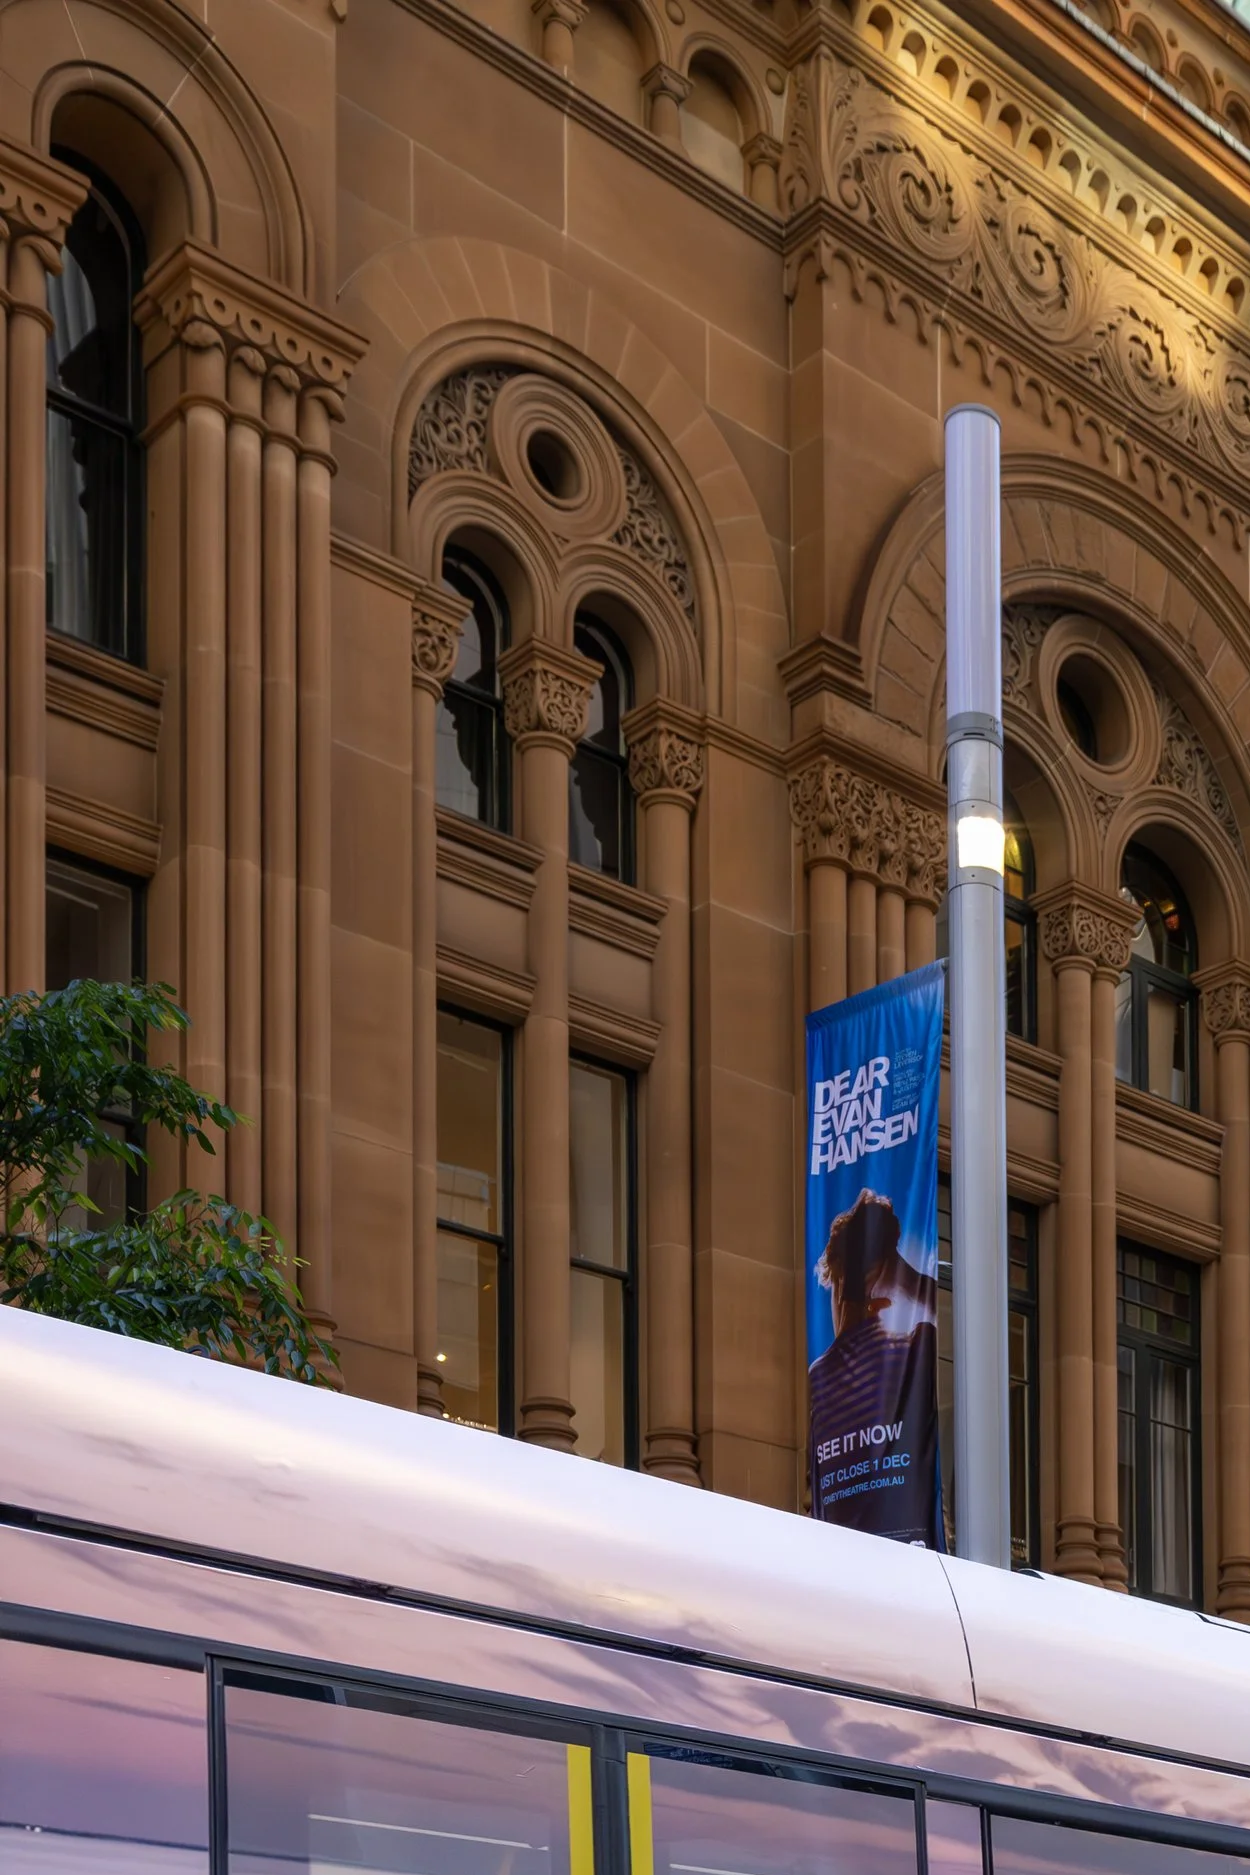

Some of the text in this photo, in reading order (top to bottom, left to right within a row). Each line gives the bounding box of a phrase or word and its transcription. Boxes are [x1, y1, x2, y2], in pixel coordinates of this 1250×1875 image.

[814, 1056, 890, 1113] DEAR
[811, 1104, 919, 1174] HANSEN
[813, 1088, 882, 1145] EVAN
[817, 1421, 903, 1464] SEE IT NOW
[820, 1453, 911, 1490] UST CLOSE 1 DEC
